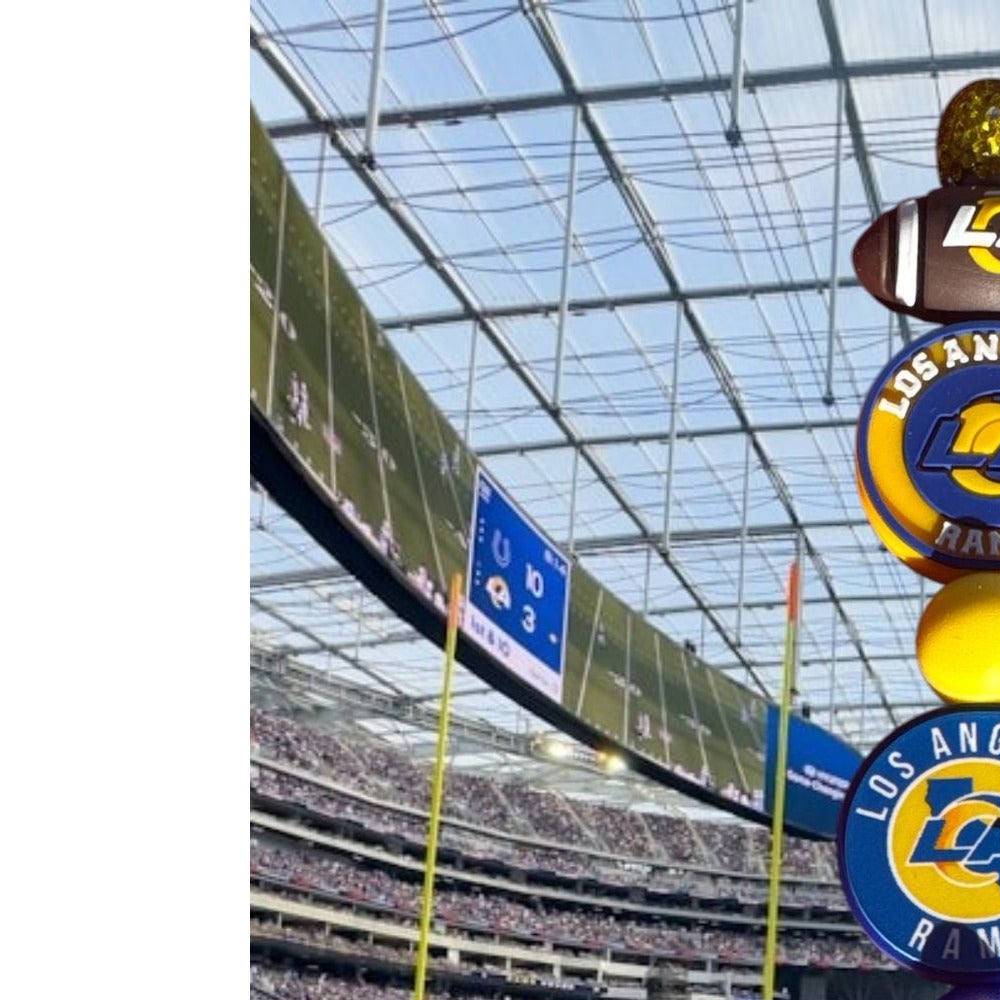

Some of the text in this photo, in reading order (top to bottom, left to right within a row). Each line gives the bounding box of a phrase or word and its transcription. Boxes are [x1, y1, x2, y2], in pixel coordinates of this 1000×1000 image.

[877, 350, 939, 420] LOS
[525, 562, 545, 599] 10
[521, 604, 537, 633] 3
[855, 751, 915, 822] LOS
